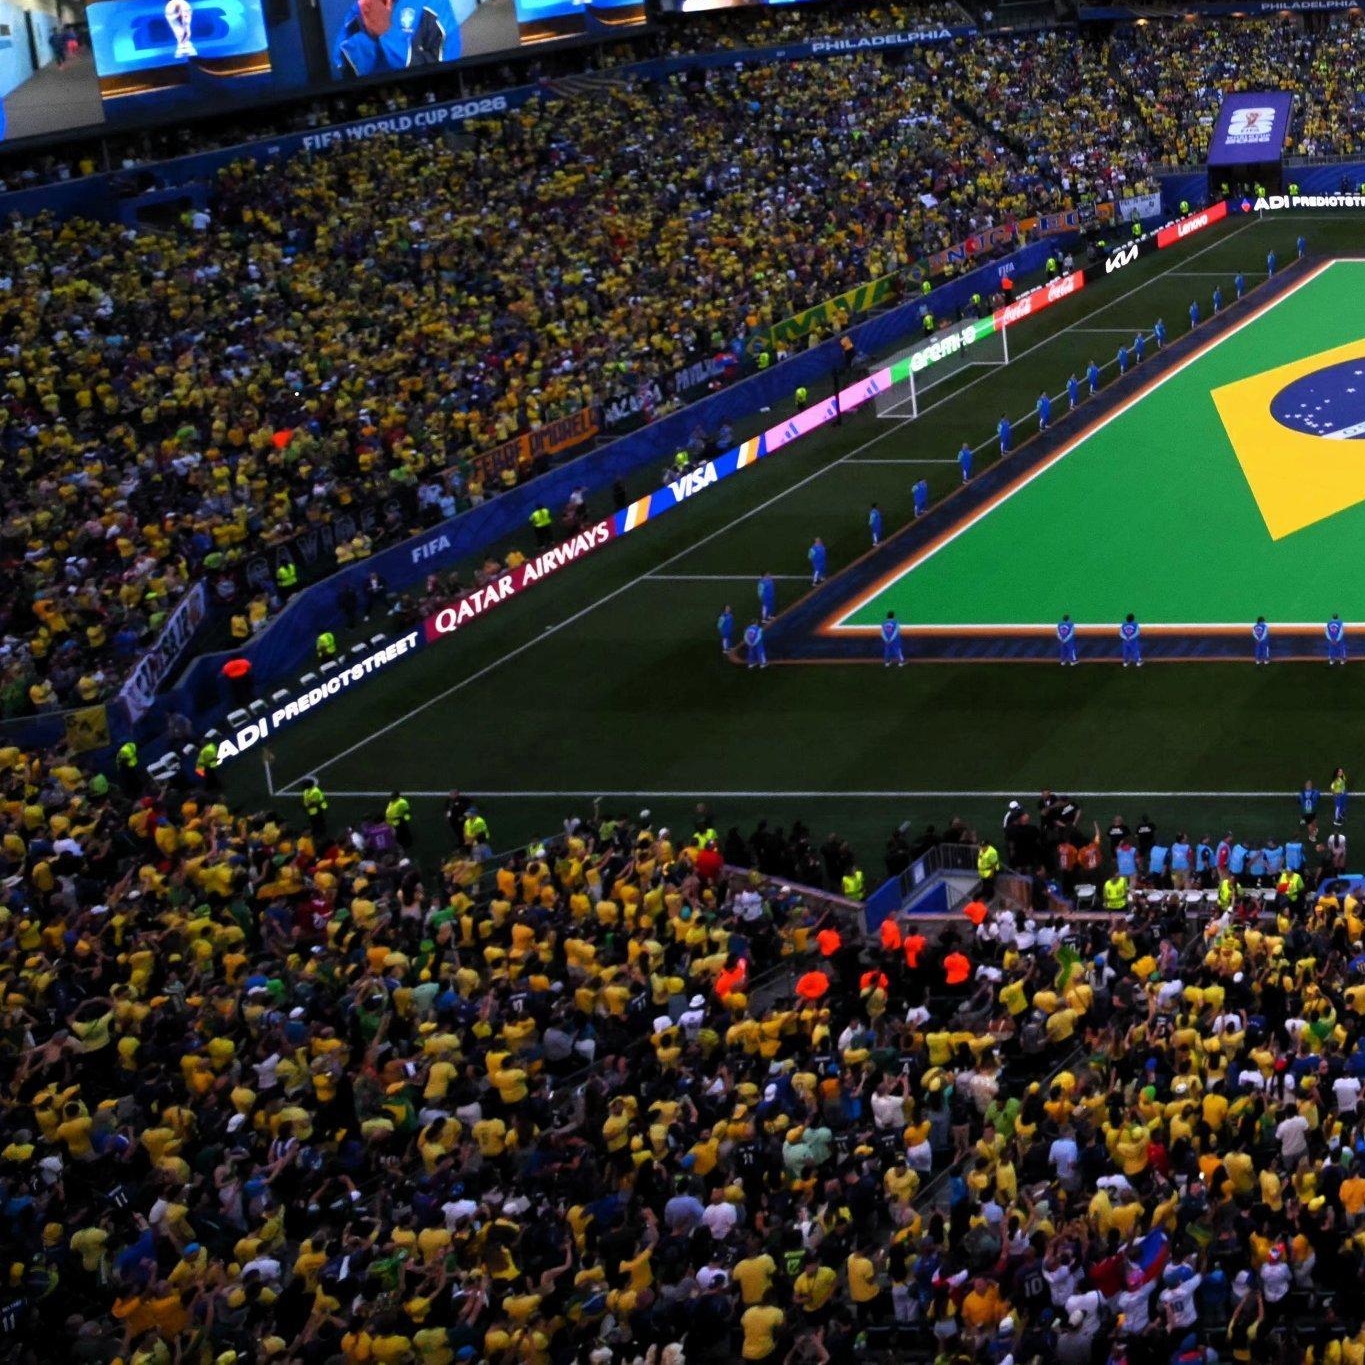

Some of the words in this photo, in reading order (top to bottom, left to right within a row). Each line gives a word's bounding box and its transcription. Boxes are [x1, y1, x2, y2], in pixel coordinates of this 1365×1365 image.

[1260, 0, 1359, 10] PHILADELPHIA
[812, 29, 952, 53] PHILADELPHIA
[346, 116, 413, 141] WORLD
[414, 107, 449, 128] CUP
[450, 95, 508, 121] 2026
[1254, 196, 1290, 211] ADI
[1177, 214, 1209, 236] Lenovo
[998, 262, 1016, 277] FIFA
[667, 460, 719, 503] VISA
[411, 534, 451, 565] FIFA
[434, 574, 515, 635] QATAR
[521, 520, 611, 588] AIRWAYS
[216, 716, 270, 766] ADI
[1022, 1275, 1043, 1299] 10
